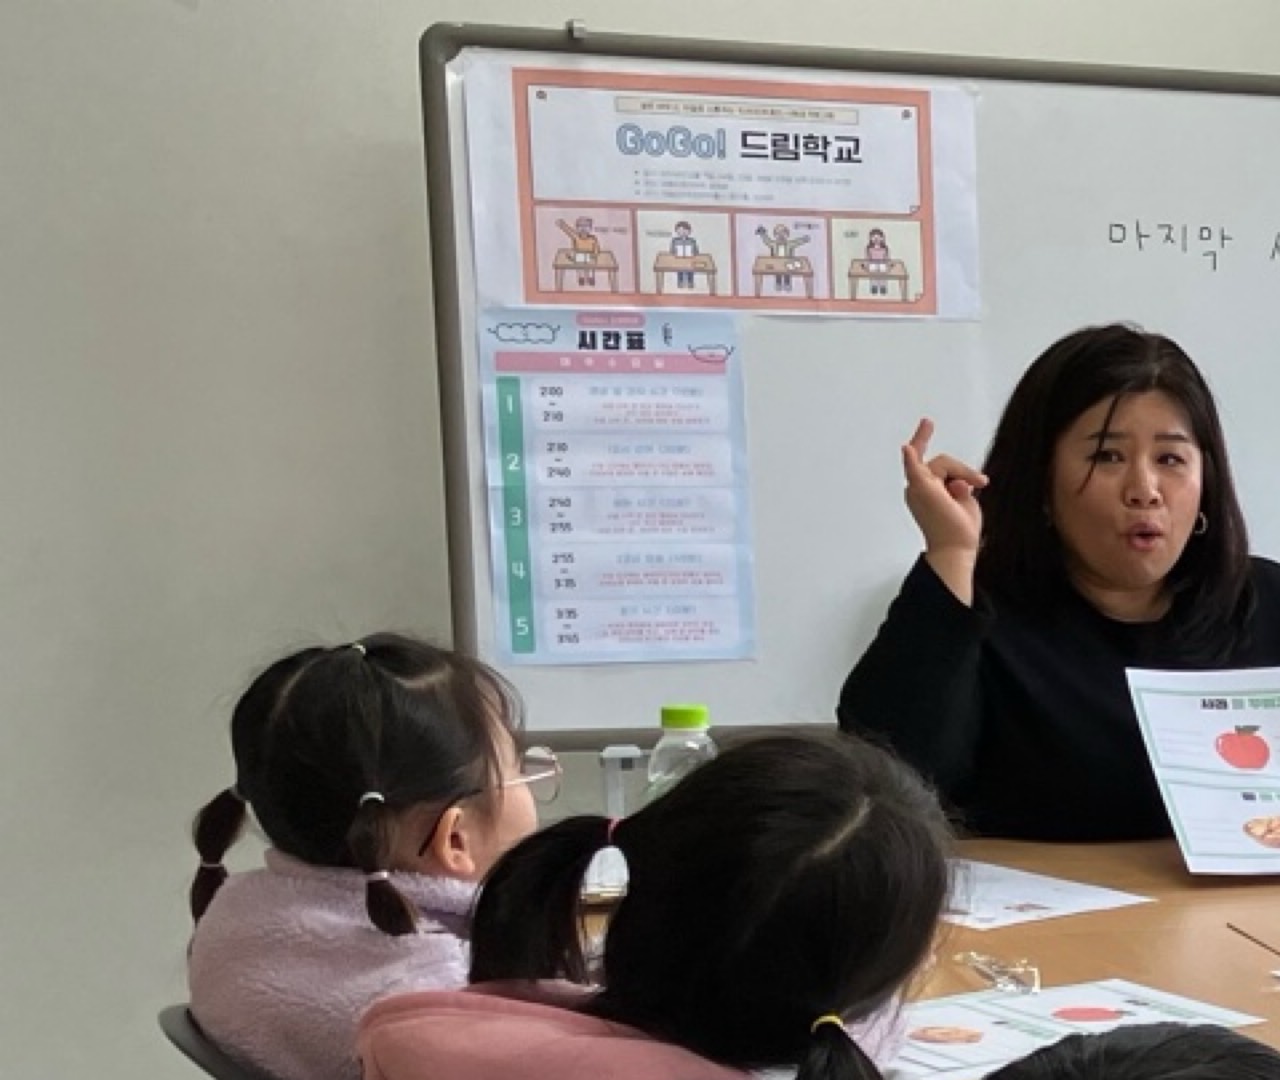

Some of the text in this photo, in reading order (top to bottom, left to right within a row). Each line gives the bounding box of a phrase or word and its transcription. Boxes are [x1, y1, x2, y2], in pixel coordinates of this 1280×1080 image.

[740, 130, 863, 164] 드림학교
[1108, 219, 1233, 272] 마지막
[578, 330, 646, 350] 시간표
[506, 453, 521, 471] 2
[511, 506, 522, 526] 3
[511, 561, 526, 579] 4
[516, 617, 529, 636] 5
